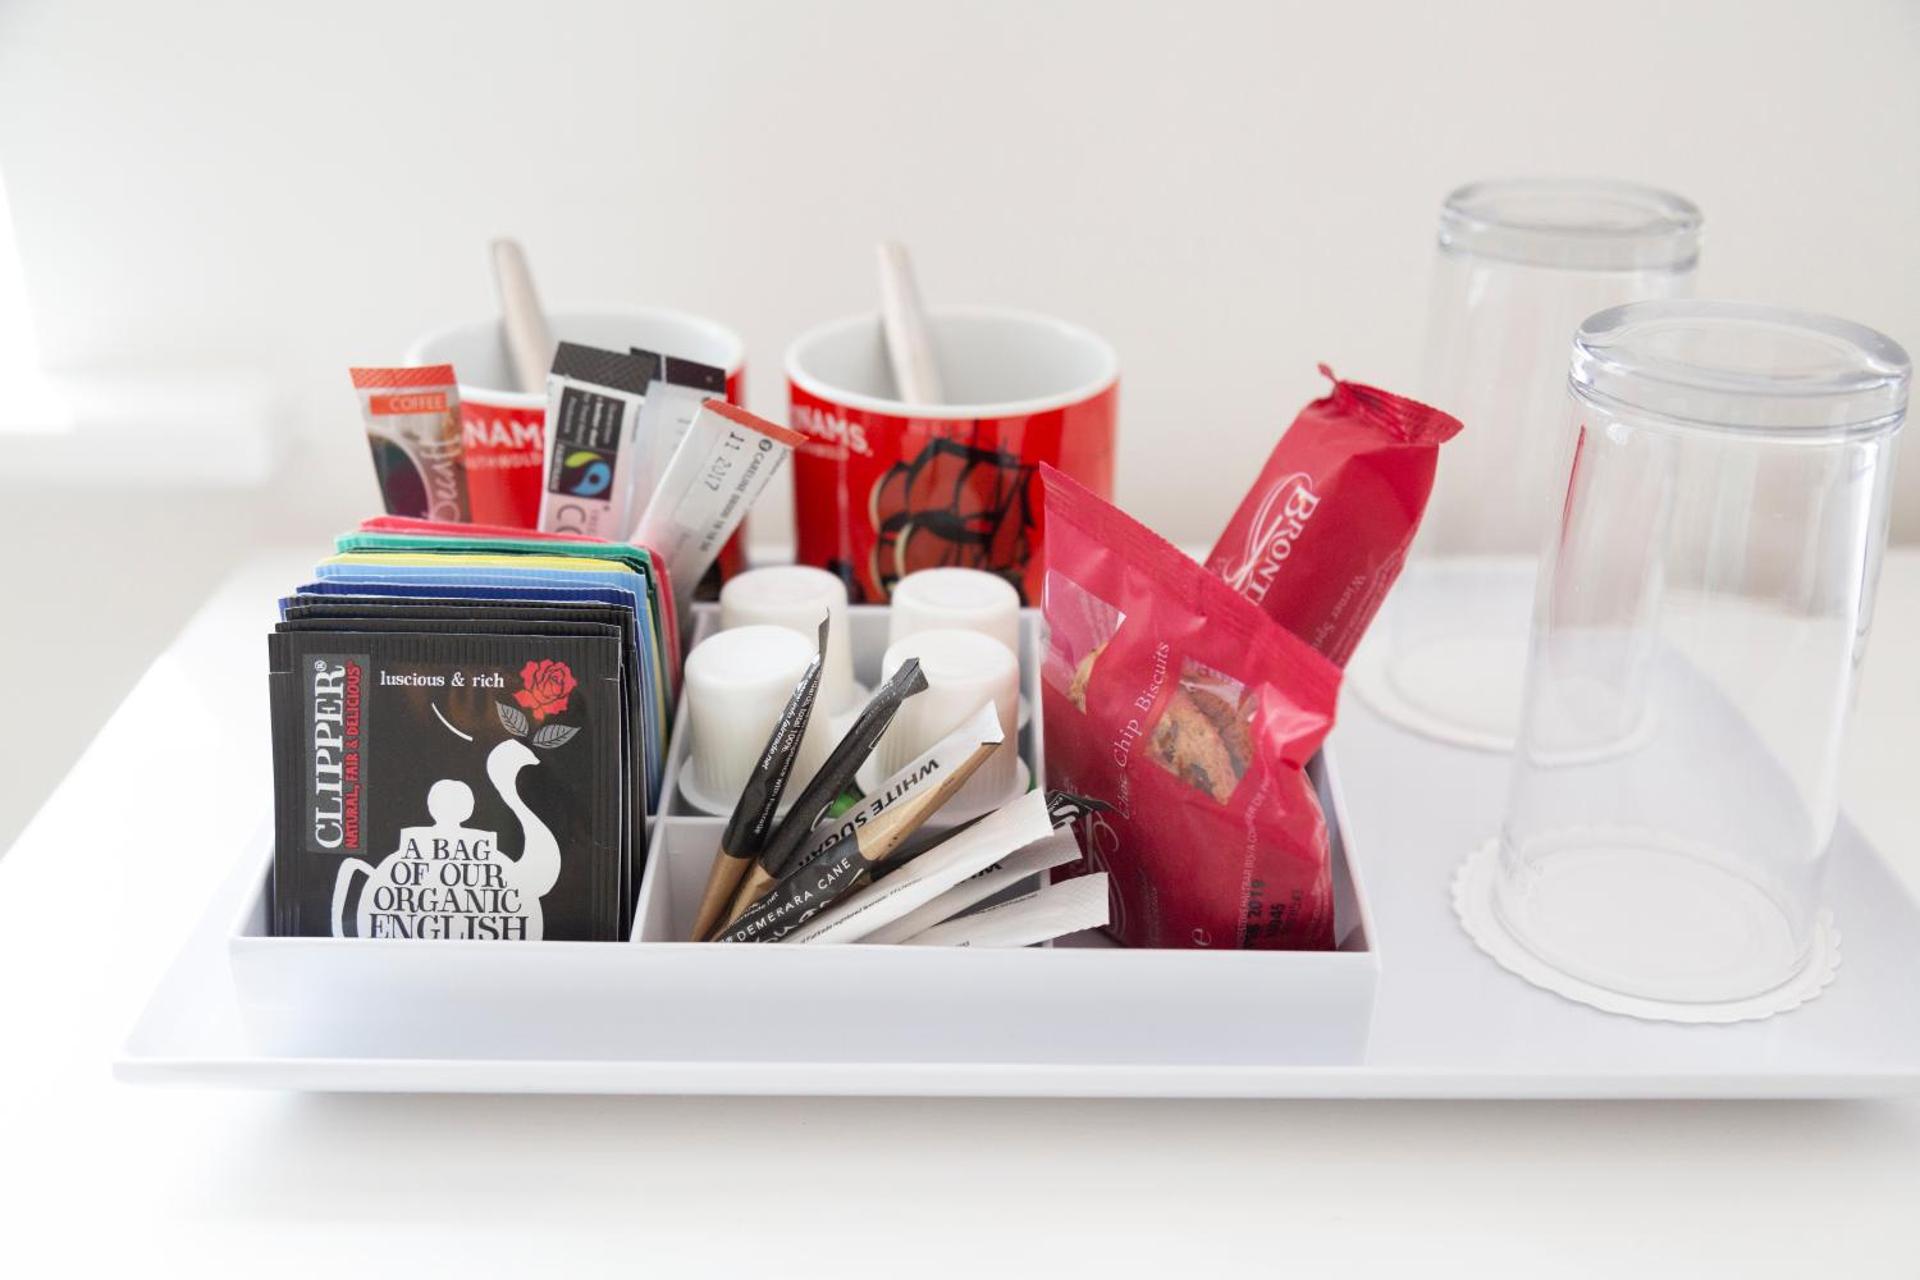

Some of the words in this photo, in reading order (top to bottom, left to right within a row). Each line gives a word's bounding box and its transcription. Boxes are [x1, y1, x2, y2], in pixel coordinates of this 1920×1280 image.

[389, 394, 444, 412] COFFEE
[703, 456, 732, 491] 2017
[1243, 486, 1322, 606] BRONT
[380, 671, 445, 687] luscious
[451, 672, 465, 687] &
[472, 673, 505, 688] rich
[345, 663, 362, 738] DELICIOUS
[1113, 718, 1143, 768] Chip
[1134, 641, 1170, 714] Biscuits
[344, 750, 361, 781] FAIR
[872, 758, 941, 817] WHITE
[402, 838, 421, 860] A
[431, 839, 492, 861] BAG
[799, 809, 869, 866] SUGA
[390, 862, 429, 886] OF
[439, 863, 508, 888] OUR
[373, 887, 523, 914] ORGANIC
[736, 889, 814, 942] DEMERARA
[817, 857, 852, 891] CANE
[368, 913, 529, 940] ENGLISH
